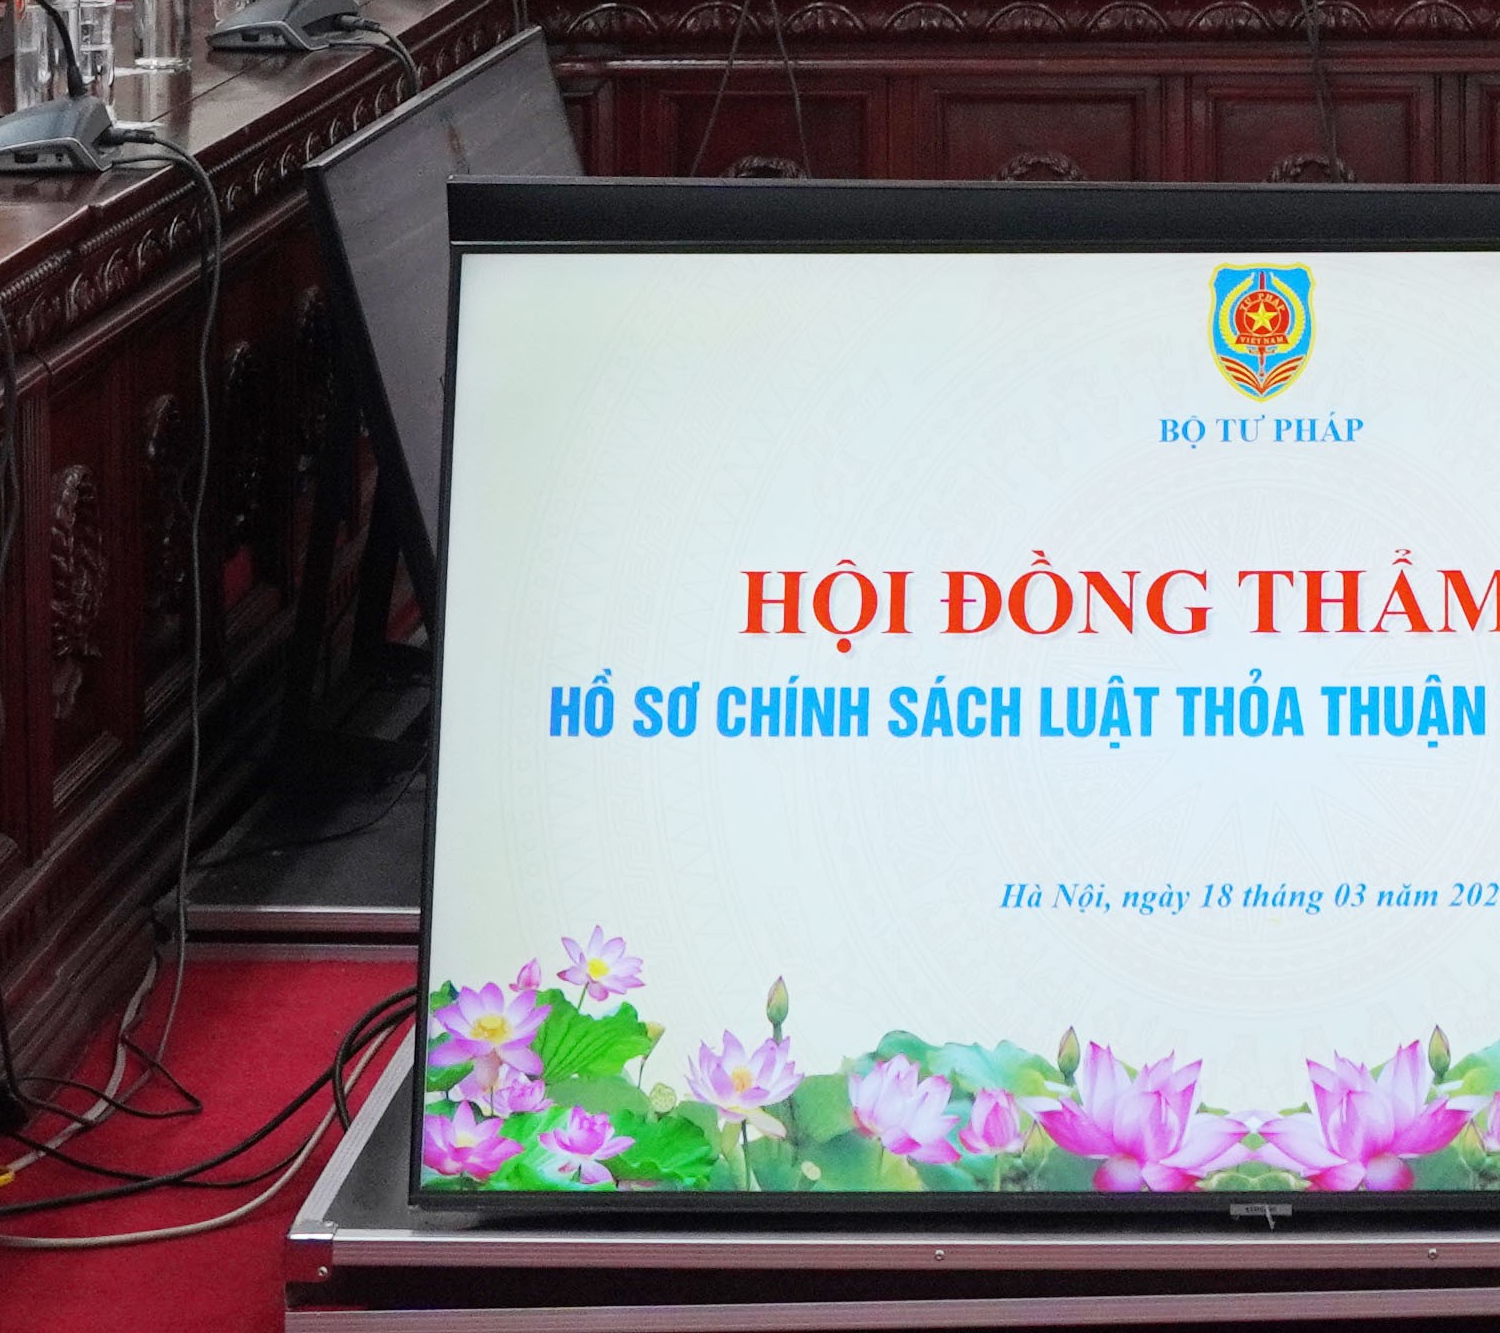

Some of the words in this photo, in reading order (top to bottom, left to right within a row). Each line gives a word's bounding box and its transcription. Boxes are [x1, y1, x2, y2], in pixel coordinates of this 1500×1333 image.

[1159, 415, 1206, 449] BỘ
[1216, 414, 1266, 443] TƯ
[1273, 411, 1364, 443] PHÁP
[742, 559, 911, 653] HỘI
[941, 550, 1209, 635] ĐỒNG
[548, 666, 616, 739] HỒ
[631, 679, 702, 739] SƠ
[715, 673, 871, 739] CHÍNH
[886, 673, 1023, 739] SÁCH
[1039, 673, 1161, 749] LUẬT
[1174, 666, 1306, 739] THỎA
[1319, 673, 1487, 749] THUẬN
[1000, 882, 1043, 909] Hà
[1053, 882, 1112, 914] Nội,
[1121, 883, 1191, 916] ngày
[1200, 883, 1234, 909] 18
[1242, 883, 1324, 915] tháng
[1333, 881, 1368, 908] 03
[1376, 882, 1439, 908] năm
